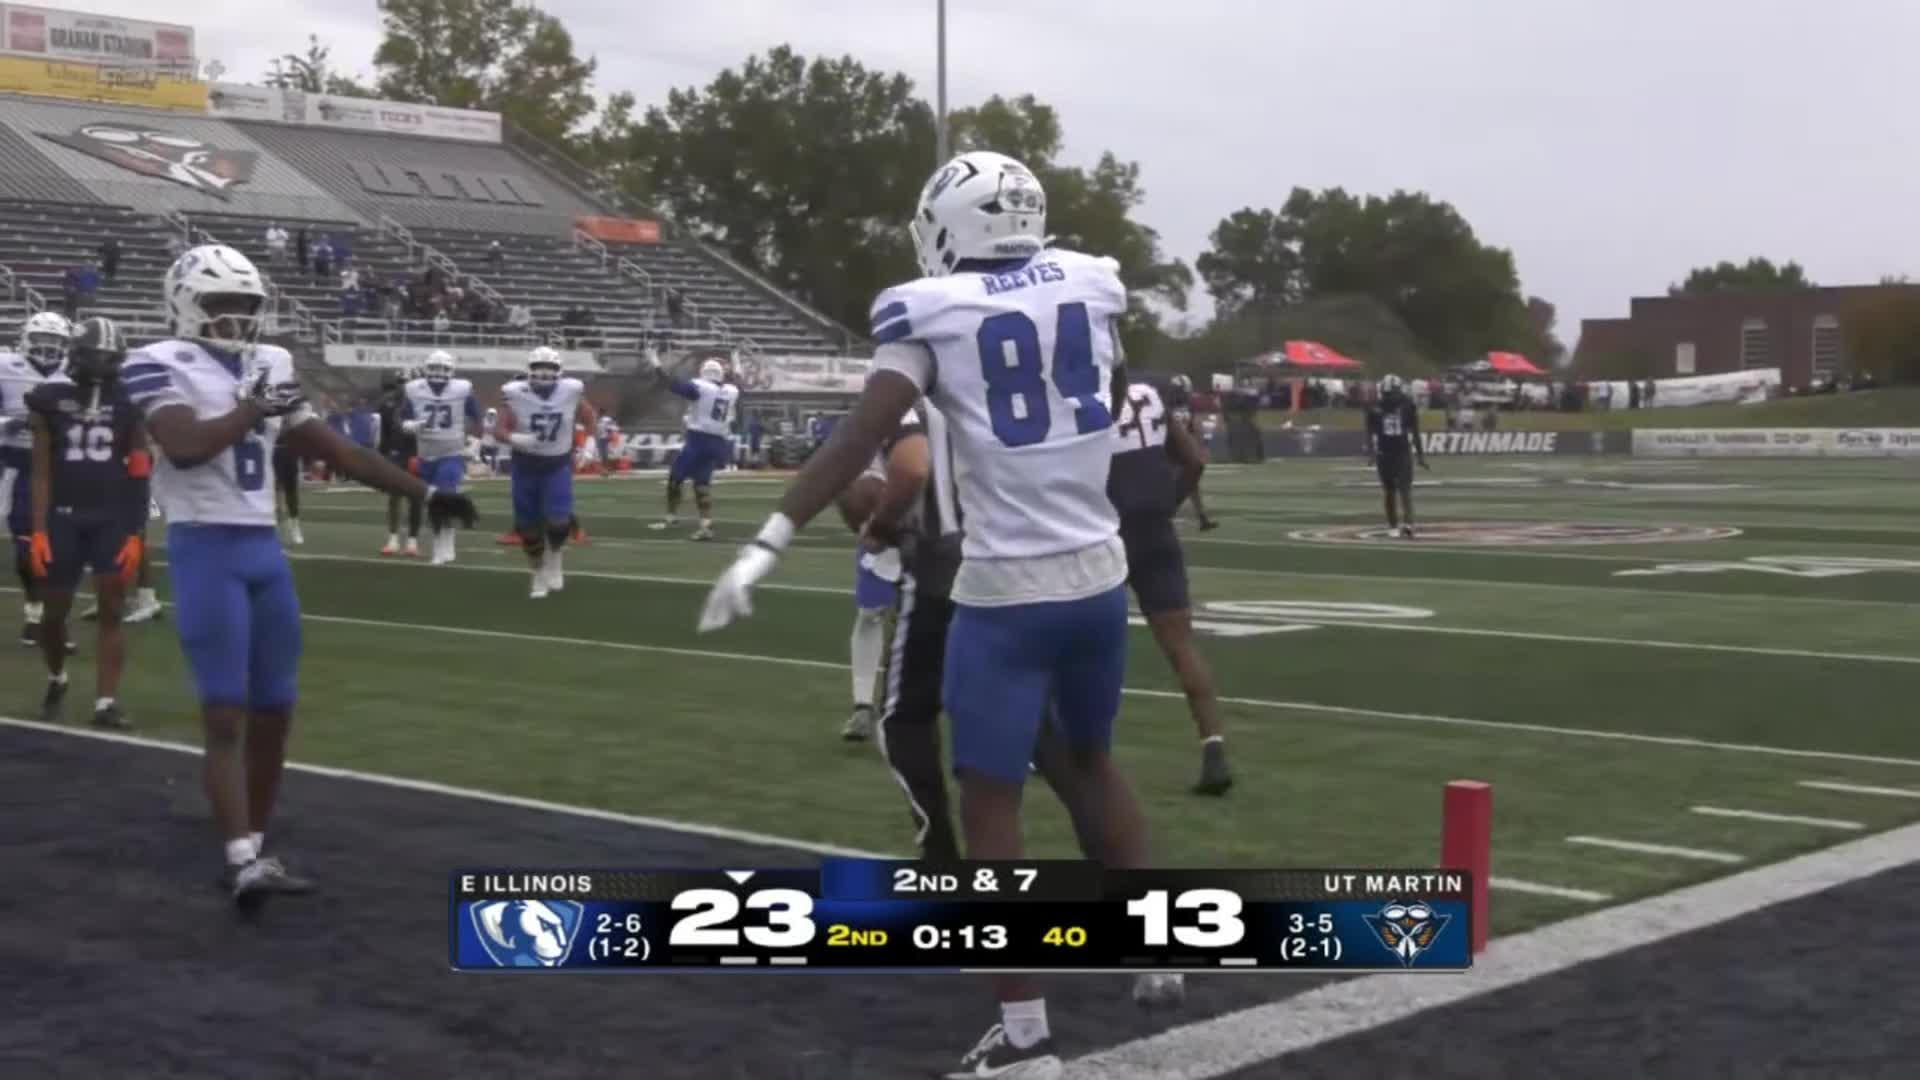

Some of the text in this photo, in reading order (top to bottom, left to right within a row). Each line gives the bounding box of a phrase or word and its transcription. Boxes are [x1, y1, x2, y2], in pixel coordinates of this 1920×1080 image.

[982, 261, 1066, 296] REEVES
[977, 301, 1113, 448] 84
[424, 404, 452, 429] 73
[530, 411, 563, 442] 57
